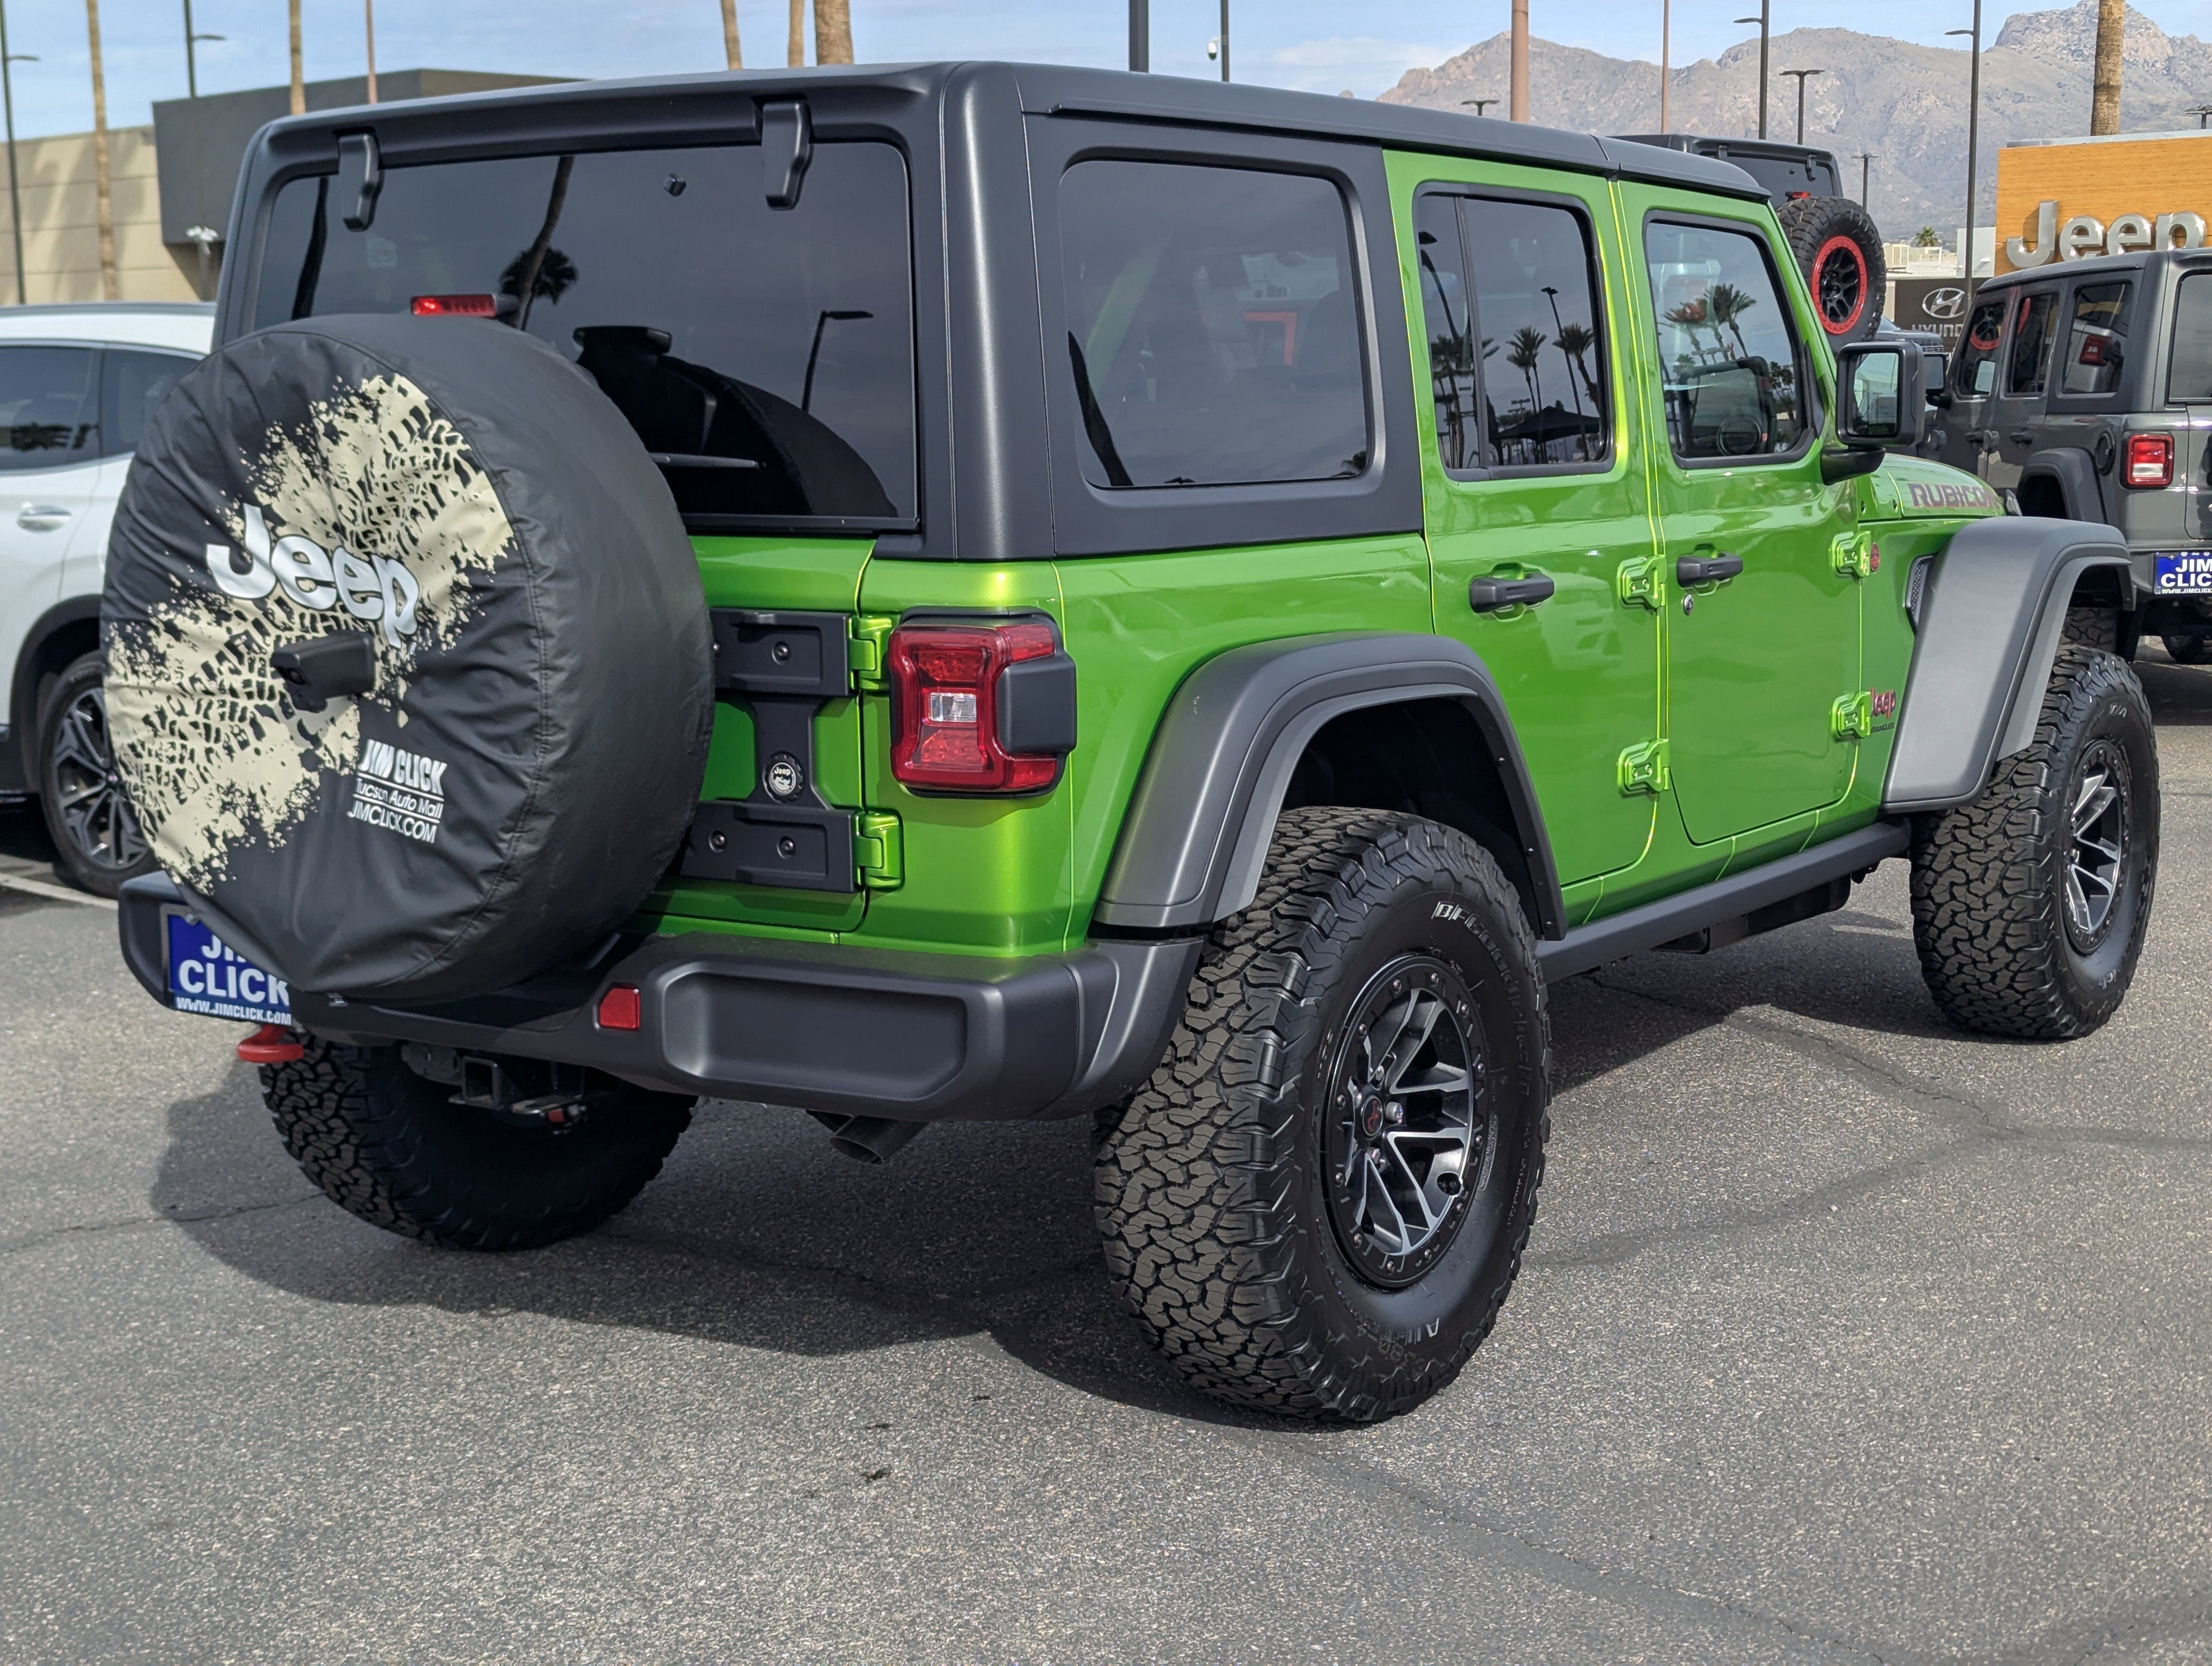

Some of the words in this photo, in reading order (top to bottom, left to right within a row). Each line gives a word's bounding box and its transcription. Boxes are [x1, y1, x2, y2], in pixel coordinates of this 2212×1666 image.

[206, 503, 420, 649] Jeep
[2175, 559, 2212, 572] JIM
[358, 739, 395, 778] JIM
[394, 749, 448, 796] CLICK
[774, 766, 791, 777] Jeep
[355, 778, 389, 802] Tucson
[389, 790, 417, 811] Auto
[418, 798, 444, 819] Mall
[178, 959, 290, 1007] CLICK
[176, 996, 292, 1026] WWW.JIMCLICK.COM
